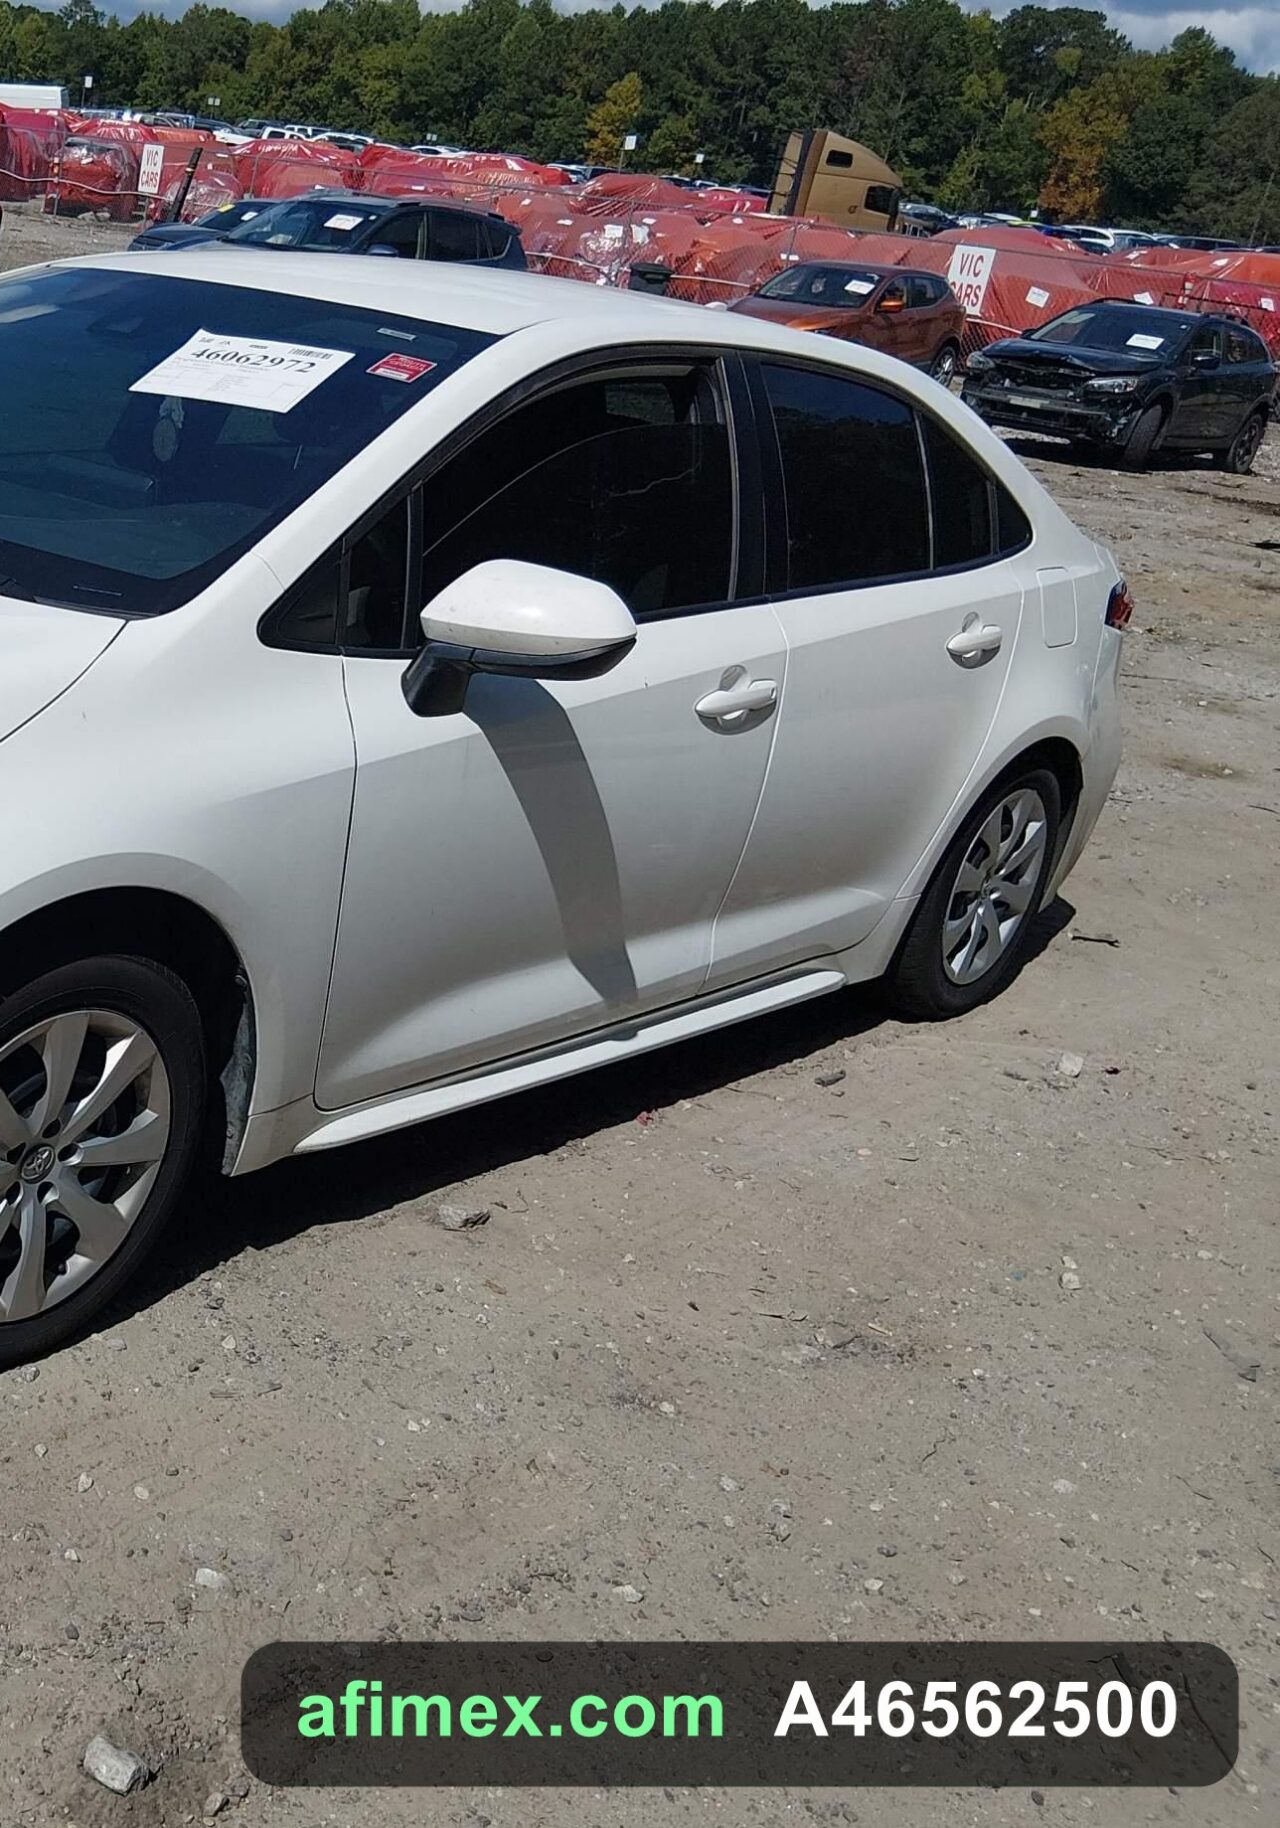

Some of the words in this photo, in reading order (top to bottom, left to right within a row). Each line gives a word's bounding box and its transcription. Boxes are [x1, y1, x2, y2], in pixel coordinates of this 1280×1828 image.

[146, 150, 159, 167] VIC
[141, 170, 159, 188] CARS
[960, 252, 984, 278] VIC
[191, 348, 317, 373] 46062972
